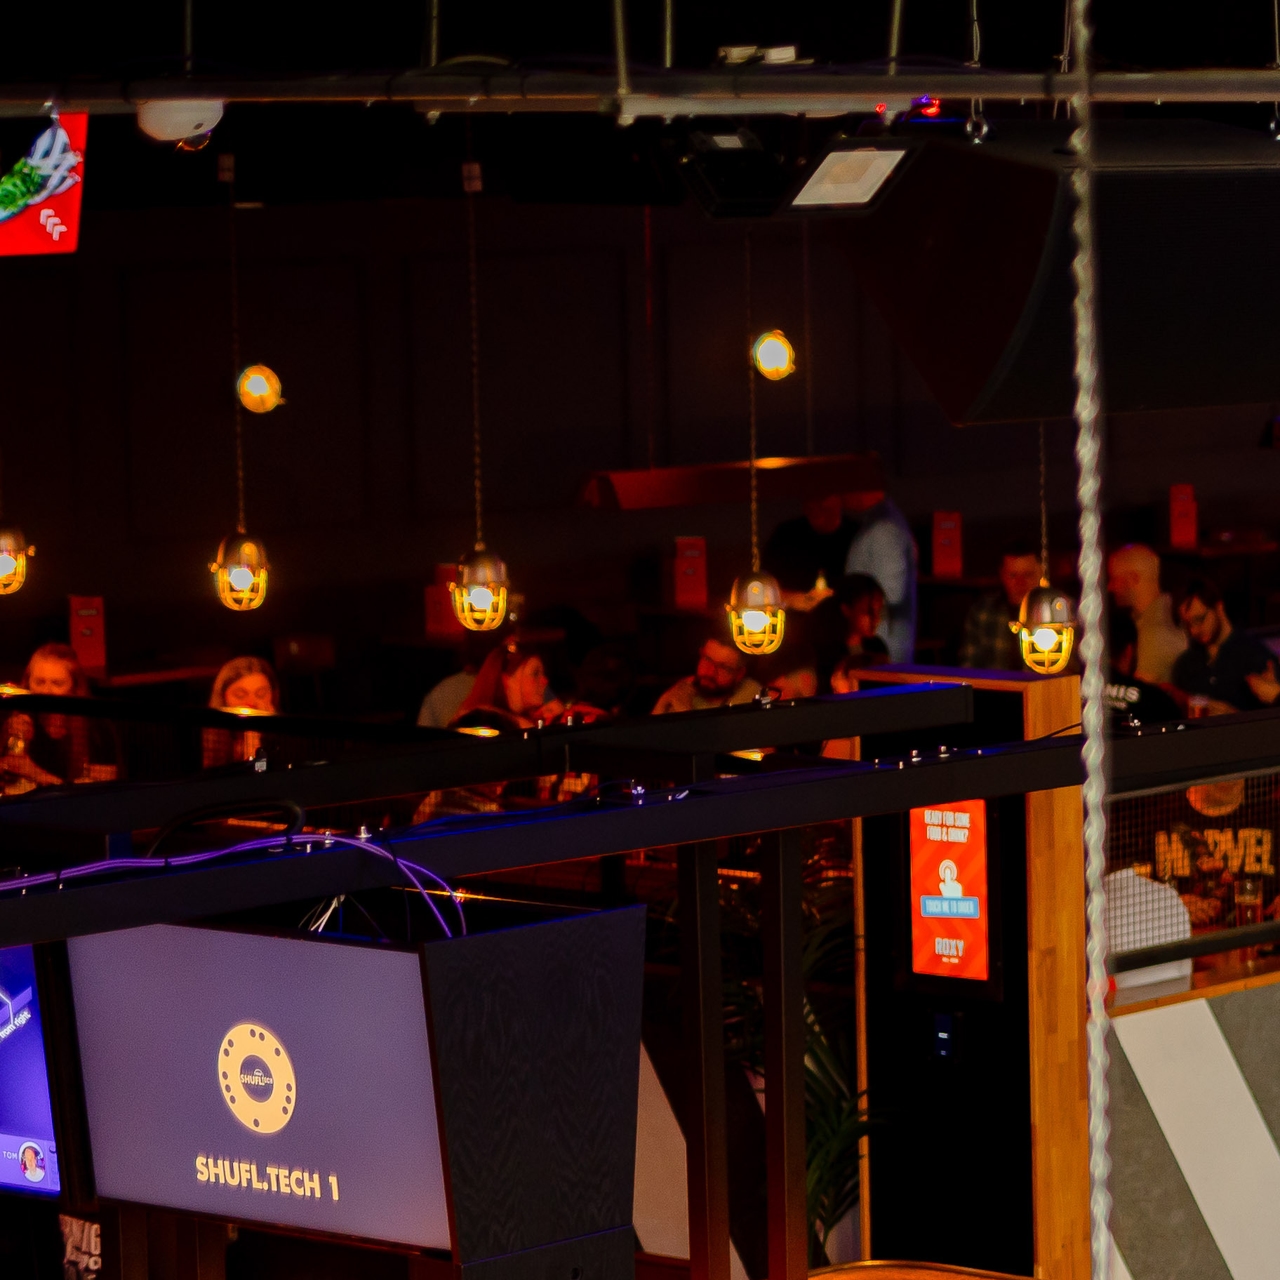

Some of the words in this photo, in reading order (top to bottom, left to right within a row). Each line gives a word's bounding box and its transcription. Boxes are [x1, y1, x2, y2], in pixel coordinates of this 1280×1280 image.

[935, 937, 964, 957] ROXY
[3, 1151, 18, 1160] TOM
[195, 1156, 321, 1198] SHUFL.TECH
[328, 1175, 339, 1201] 1
